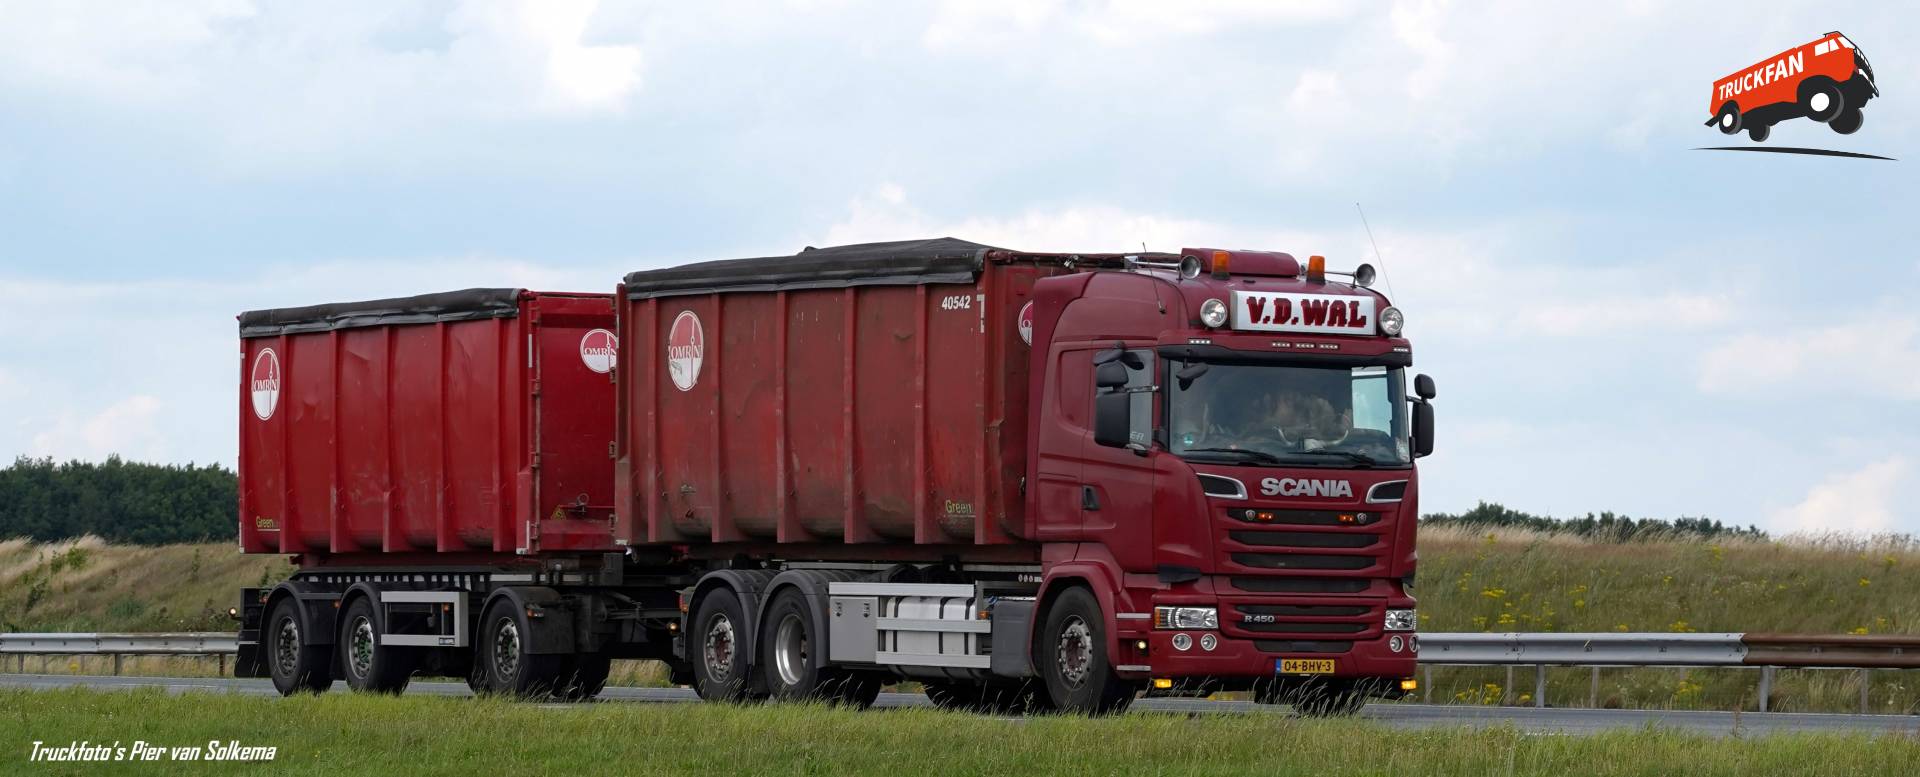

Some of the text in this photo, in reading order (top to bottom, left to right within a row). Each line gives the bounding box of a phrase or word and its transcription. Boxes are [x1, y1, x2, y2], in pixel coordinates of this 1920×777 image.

[941, 295, 971, 310] 40542
[1261, 477, 1353, 498] SCANIA
[945, 499, 972, 514] Green
[1244, 615, 1275, 623] R 450
[1284, 661, 1332, 672] 04-BHV-3
